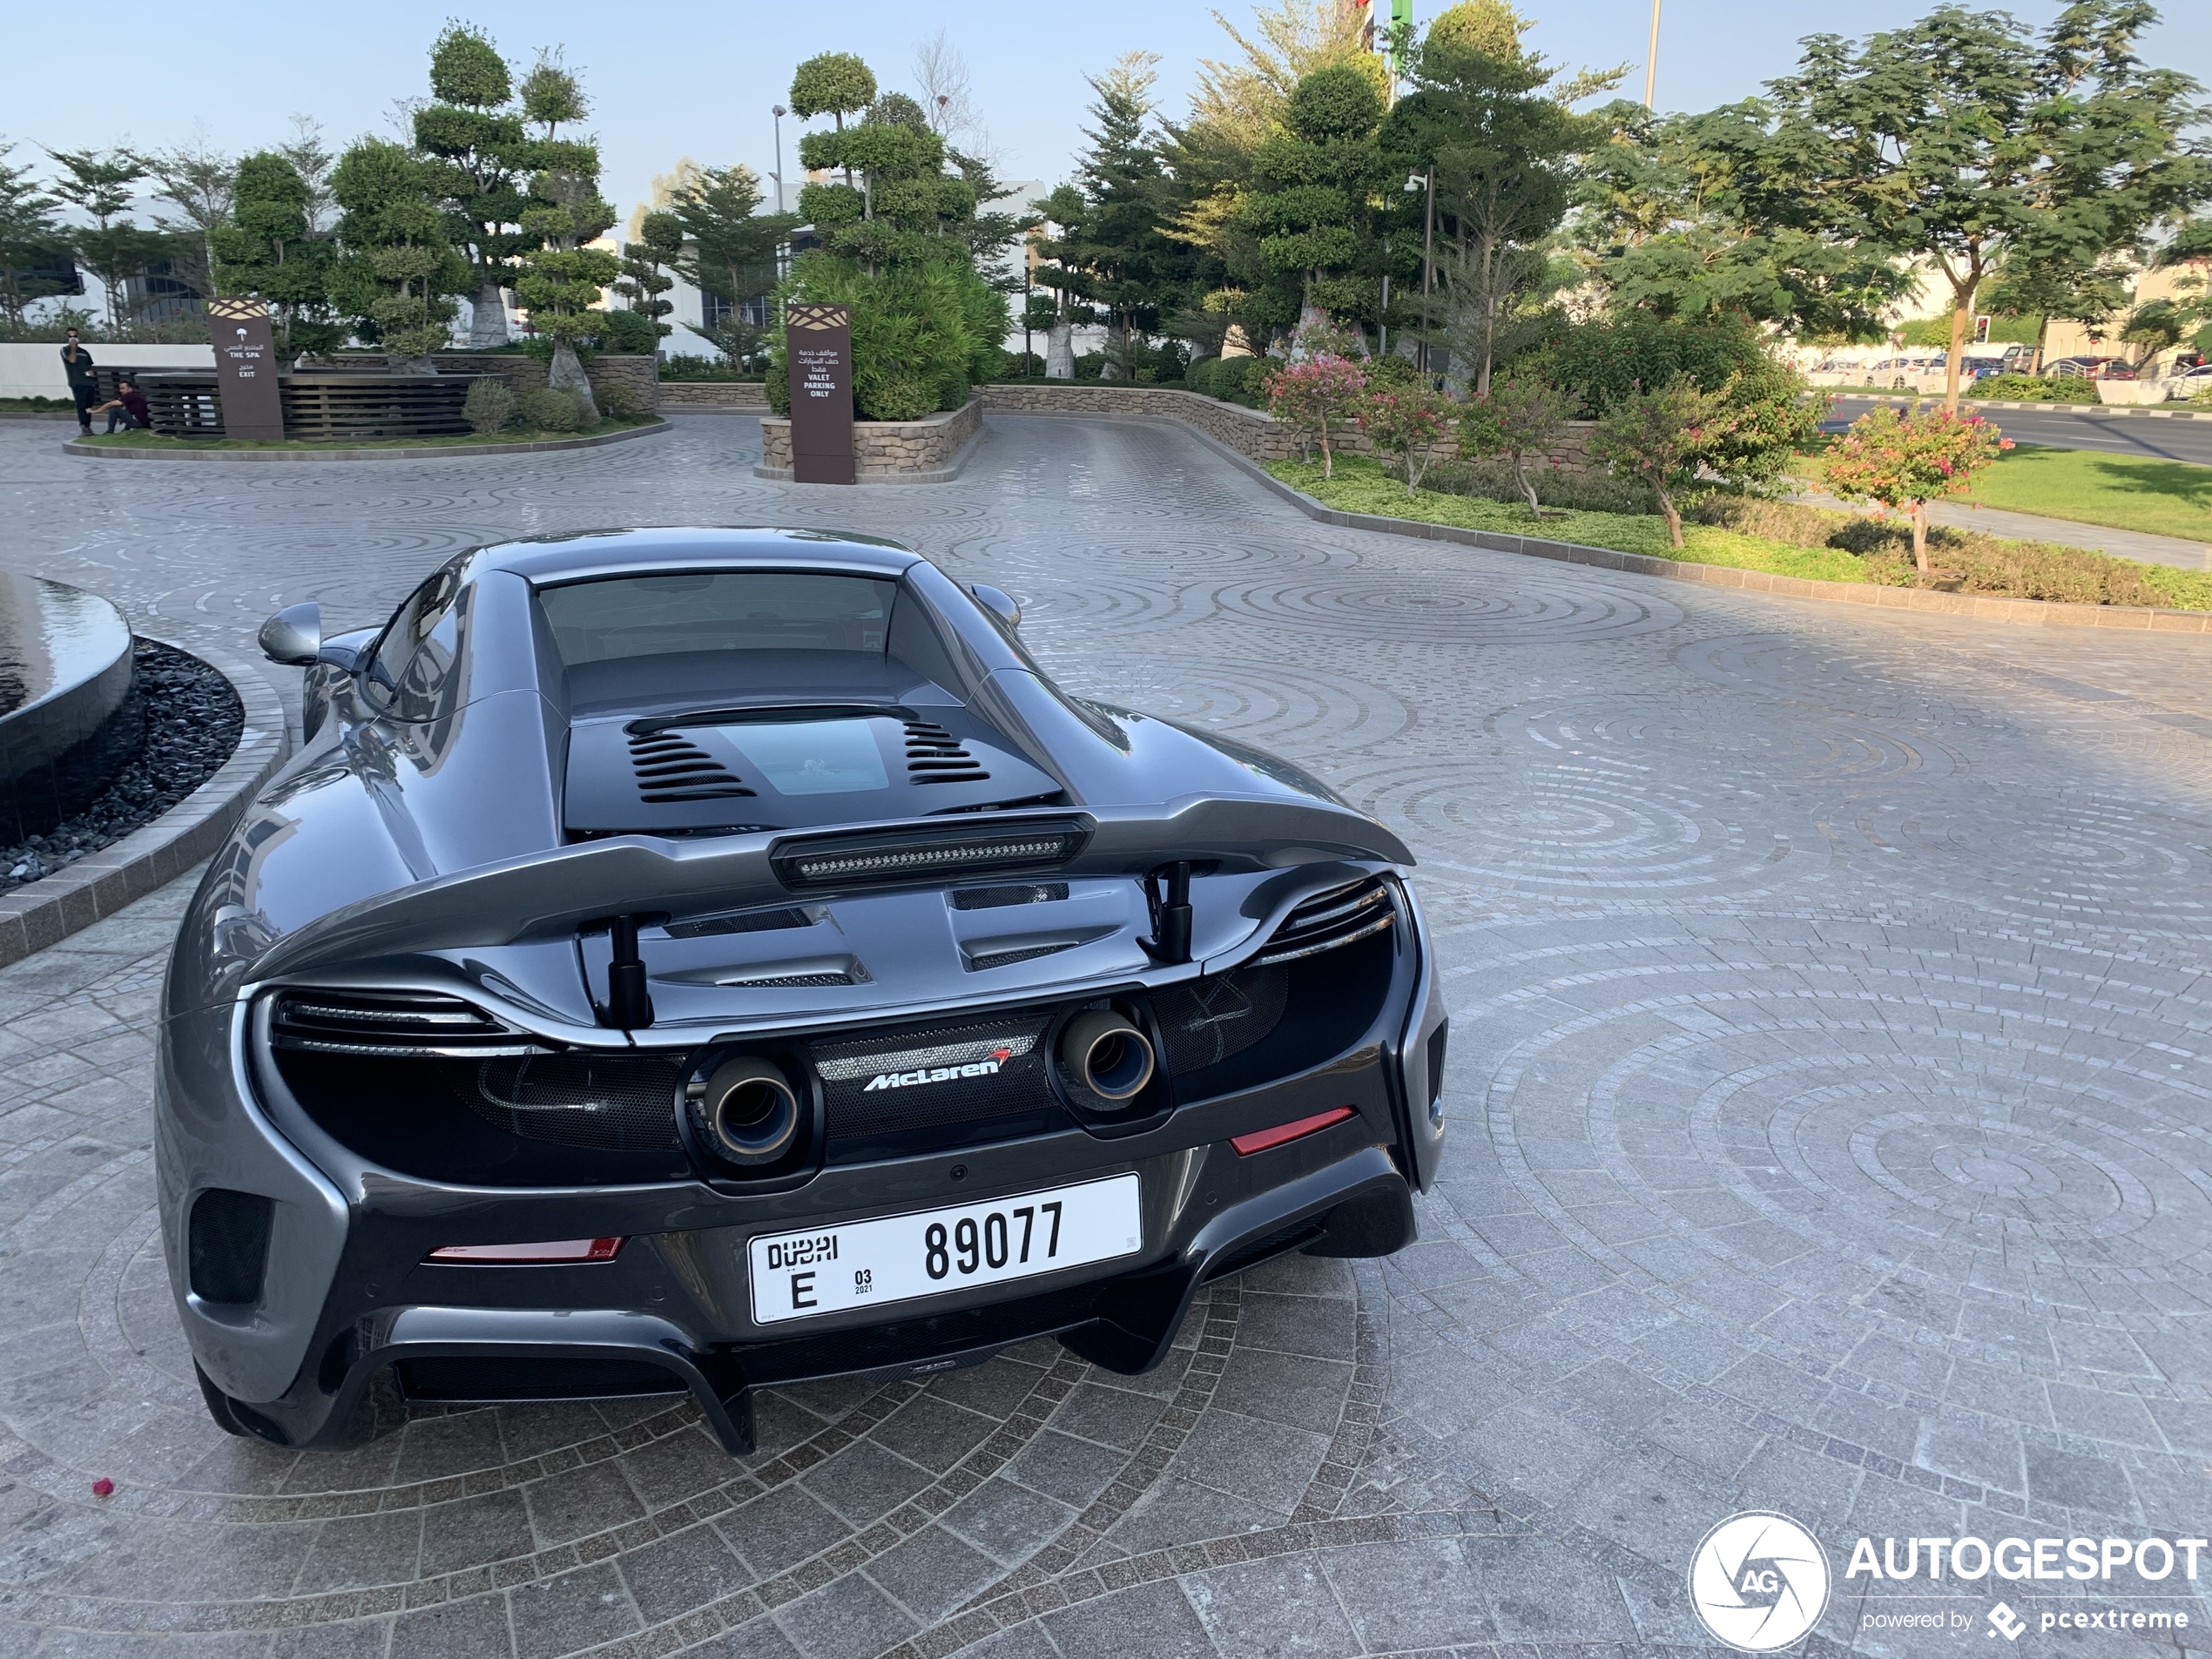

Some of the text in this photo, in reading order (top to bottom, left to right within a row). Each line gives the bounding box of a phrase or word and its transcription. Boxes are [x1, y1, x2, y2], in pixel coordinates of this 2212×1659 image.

[863, 1060, 999, 1091] McLaren
[925, 1201, 1062, 1280] 89077
[791, 1271, 818, 1309] E
[854, 1269, 872, 1285] 03
[855, 1284, 873, 1295] 2021
